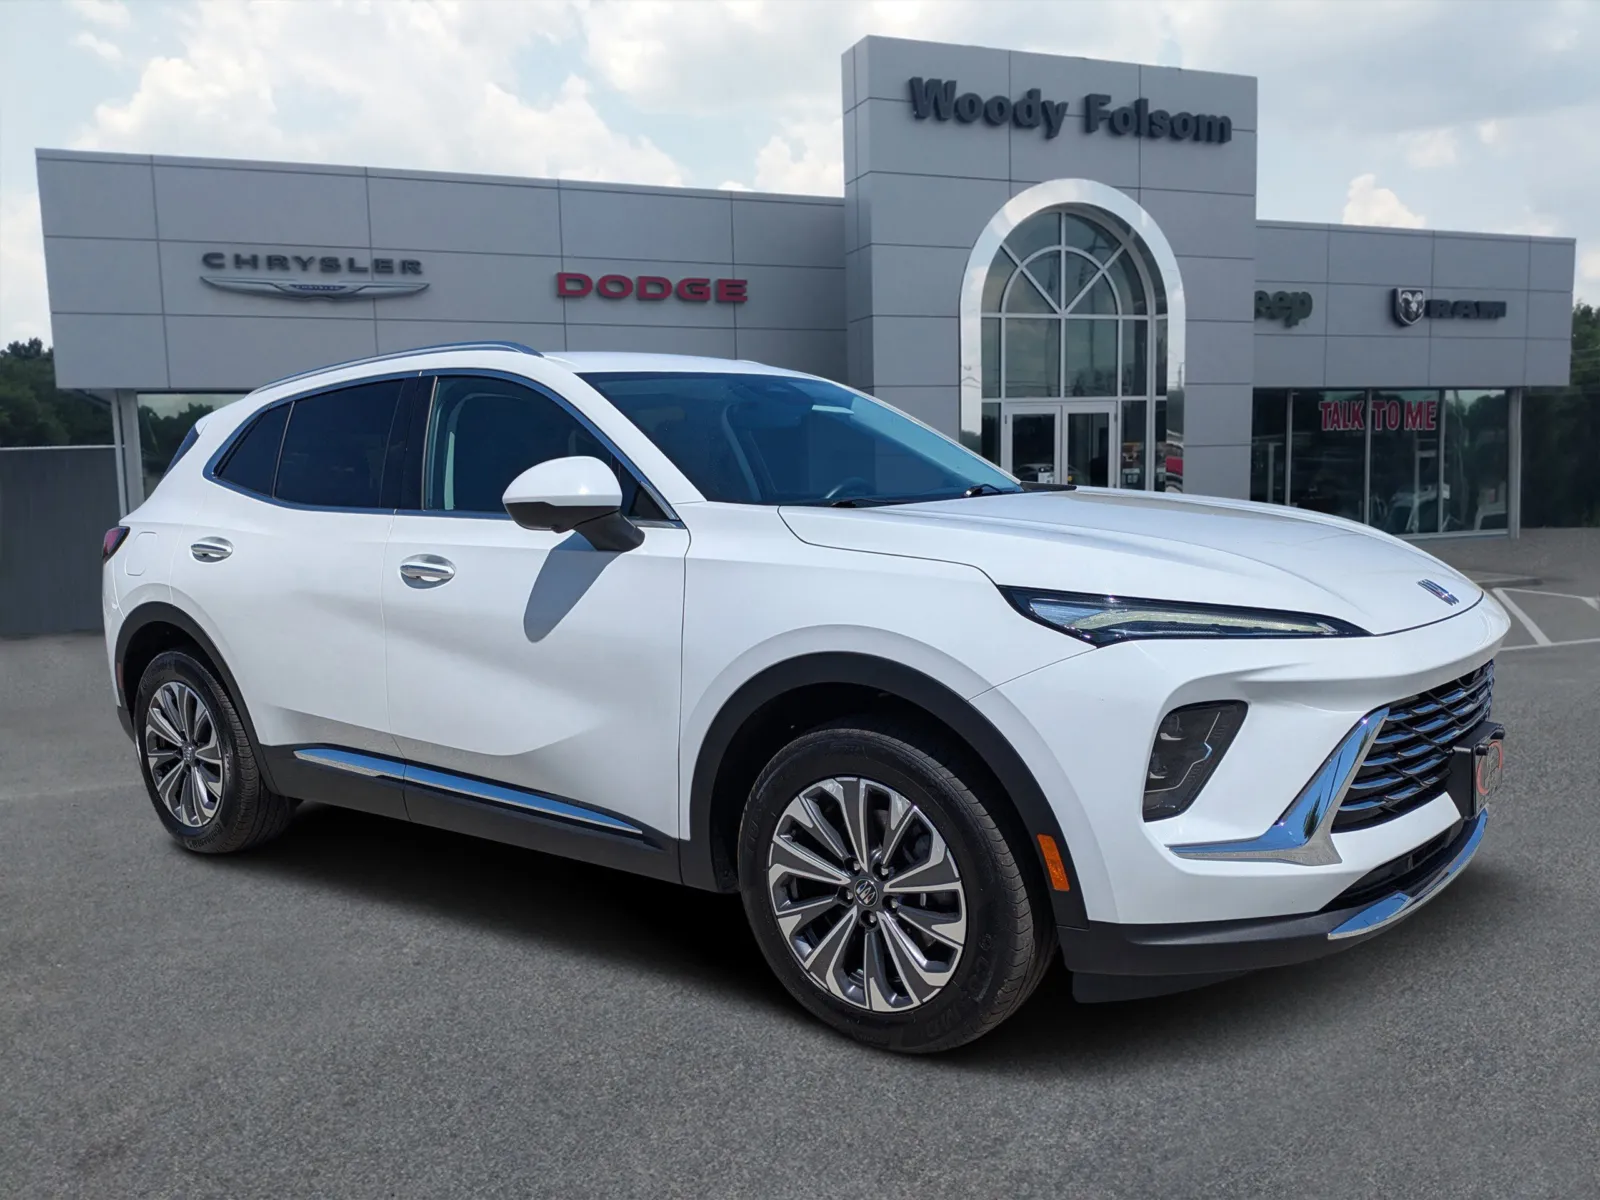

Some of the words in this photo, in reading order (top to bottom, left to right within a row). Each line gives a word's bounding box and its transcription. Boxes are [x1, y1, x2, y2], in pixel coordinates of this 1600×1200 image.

[909, 76, 1068, 140] Woody
[1083, 93, 1232, 144] Folsom
[202, 252, 423, 275] CHRYSLER
[556, 272, 749, 303] DODGE
[1254, 290, 1313, 328] eep
[1427, 300, 1507, 319] RAM
[1318, 400, 1365, 431] TALK
[1371, 400, 1400, 431] TO
[1403, 400, 1438, 431] ME
